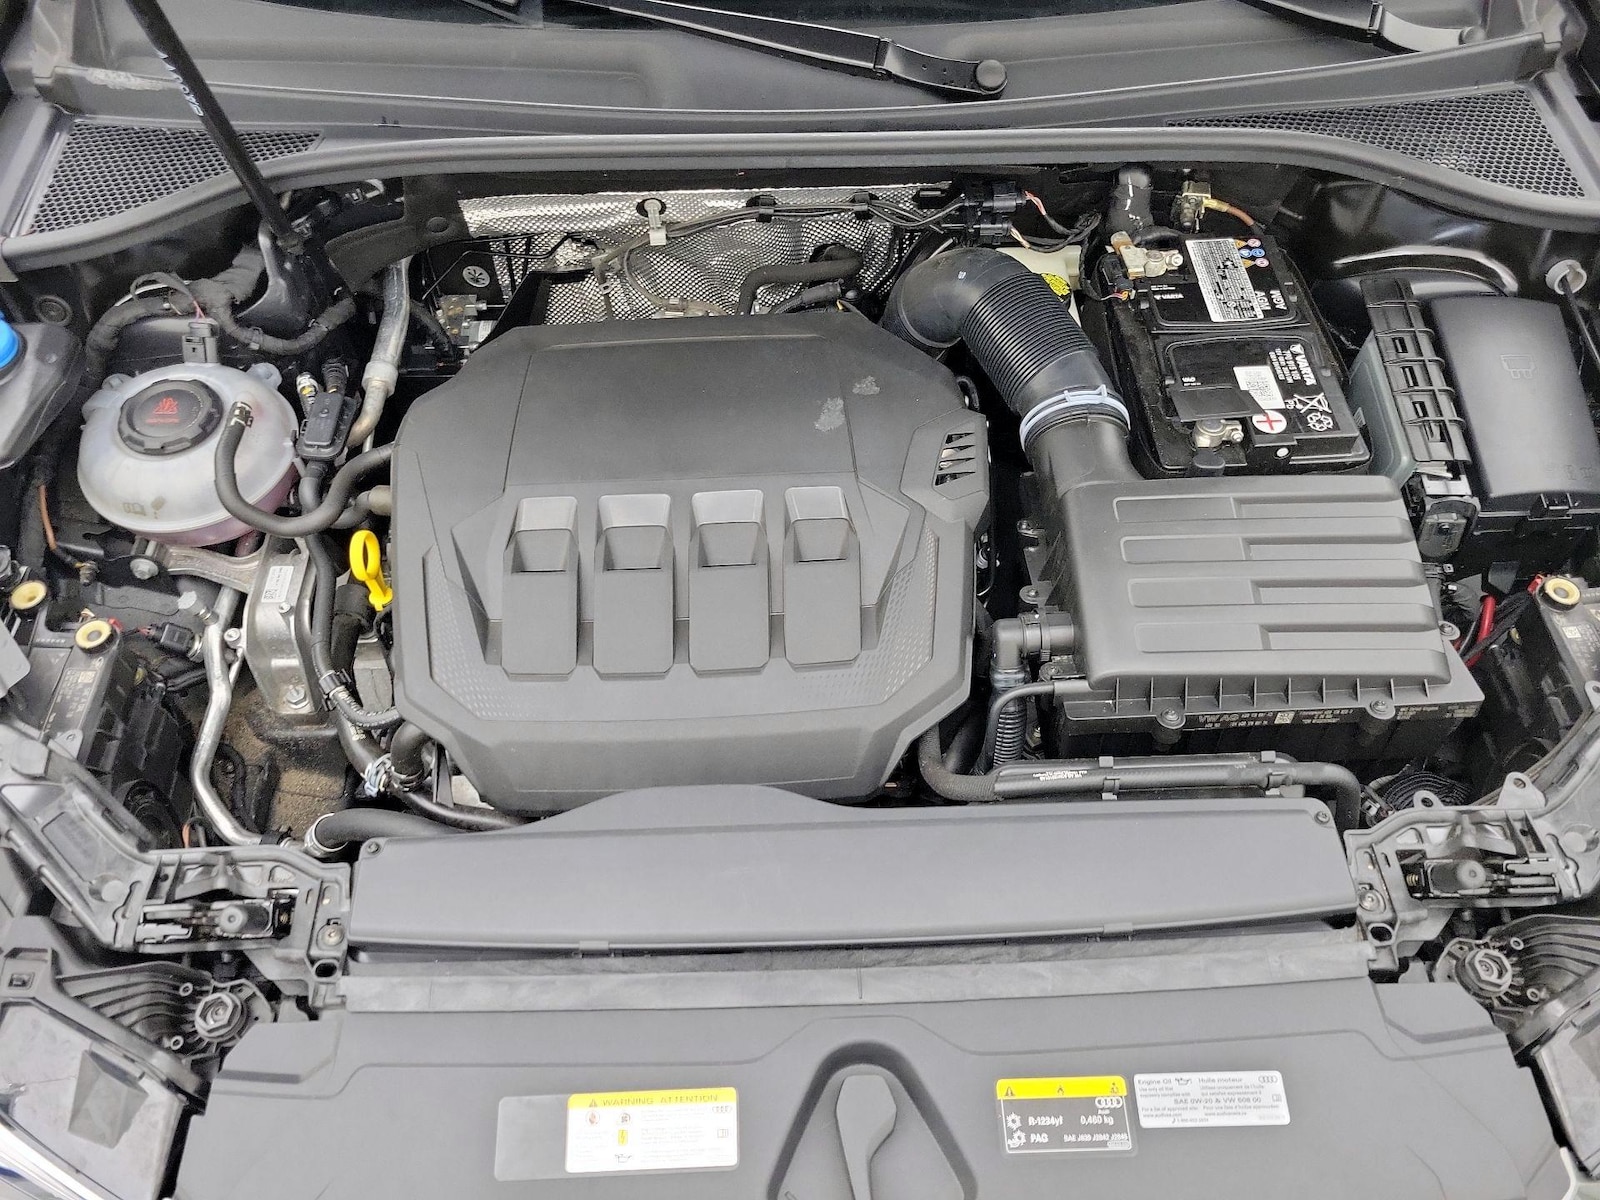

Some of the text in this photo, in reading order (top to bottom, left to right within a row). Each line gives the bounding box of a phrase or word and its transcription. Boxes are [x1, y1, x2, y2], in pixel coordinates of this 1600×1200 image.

[1254, 291, 1271, 310] AGM
[1270, 290, 1287, 310] AGM
[1296, 354, 1317, 385] VARTA
[1285, 400, 1294, 409] Pb
[602, 1095, 718, 1106] WARNING ATTENTION
[1028, 1115, 1063, 1126] R-1234yf
[1103, 1115, 1114, 1126] kg
[1030, 1133, 1049, 1143] PAG
